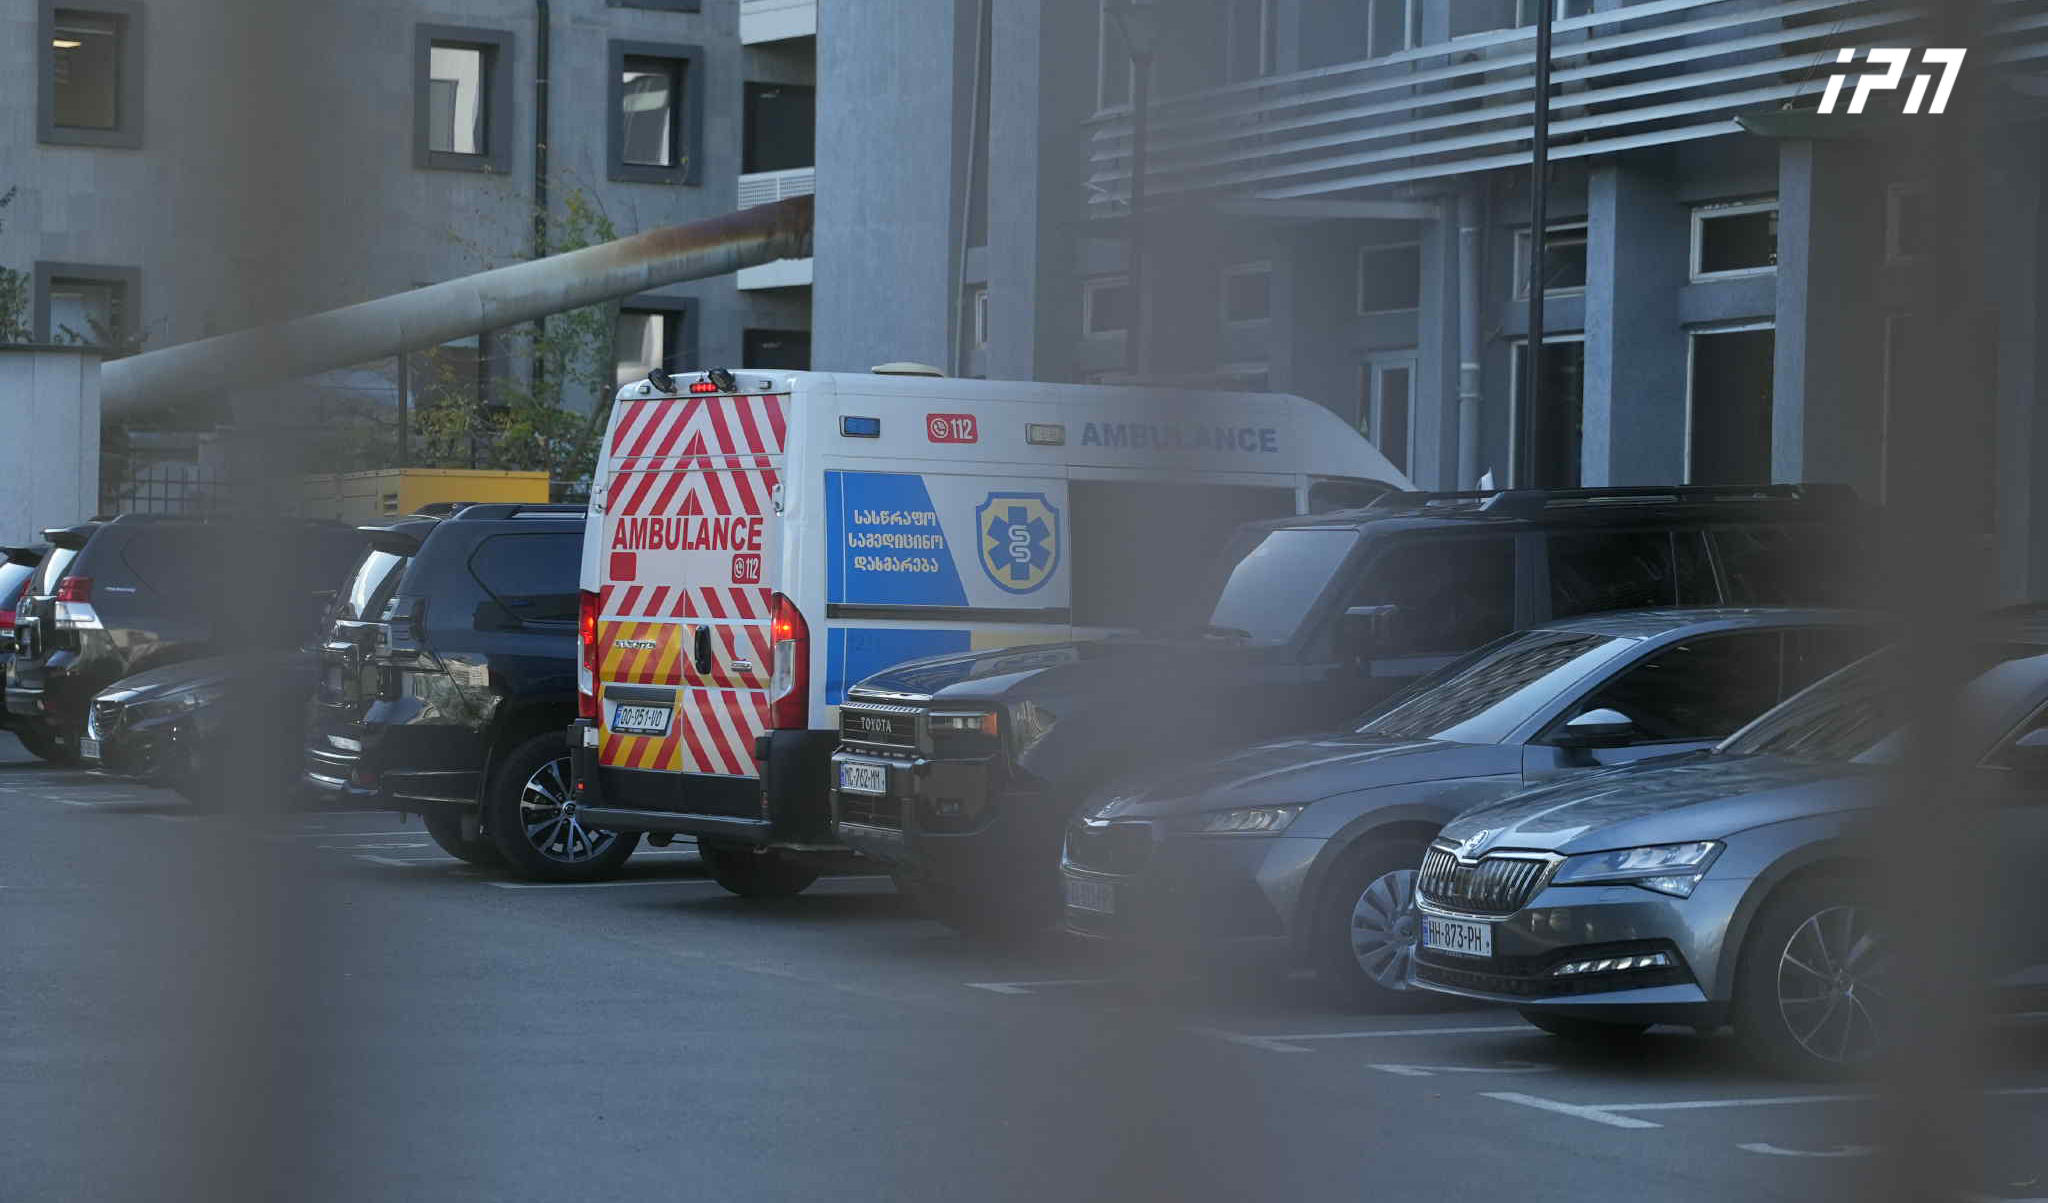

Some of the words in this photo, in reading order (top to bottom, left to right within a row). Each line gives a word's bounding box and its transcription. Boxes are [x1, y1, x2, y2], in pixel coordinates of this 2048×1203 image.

[951, 418, 973, 439] 112
[854, 509, 936, 527] სასწრაფო
[612, 517, 763, 550] AMBULANCE
[848, 532, 944, 550] სამედიცინო
[746, 557, 759, 580] 112
[861, 716, 892, 733] TOYOTA
[1429, 919, 1482, 951] HH-873-PH
